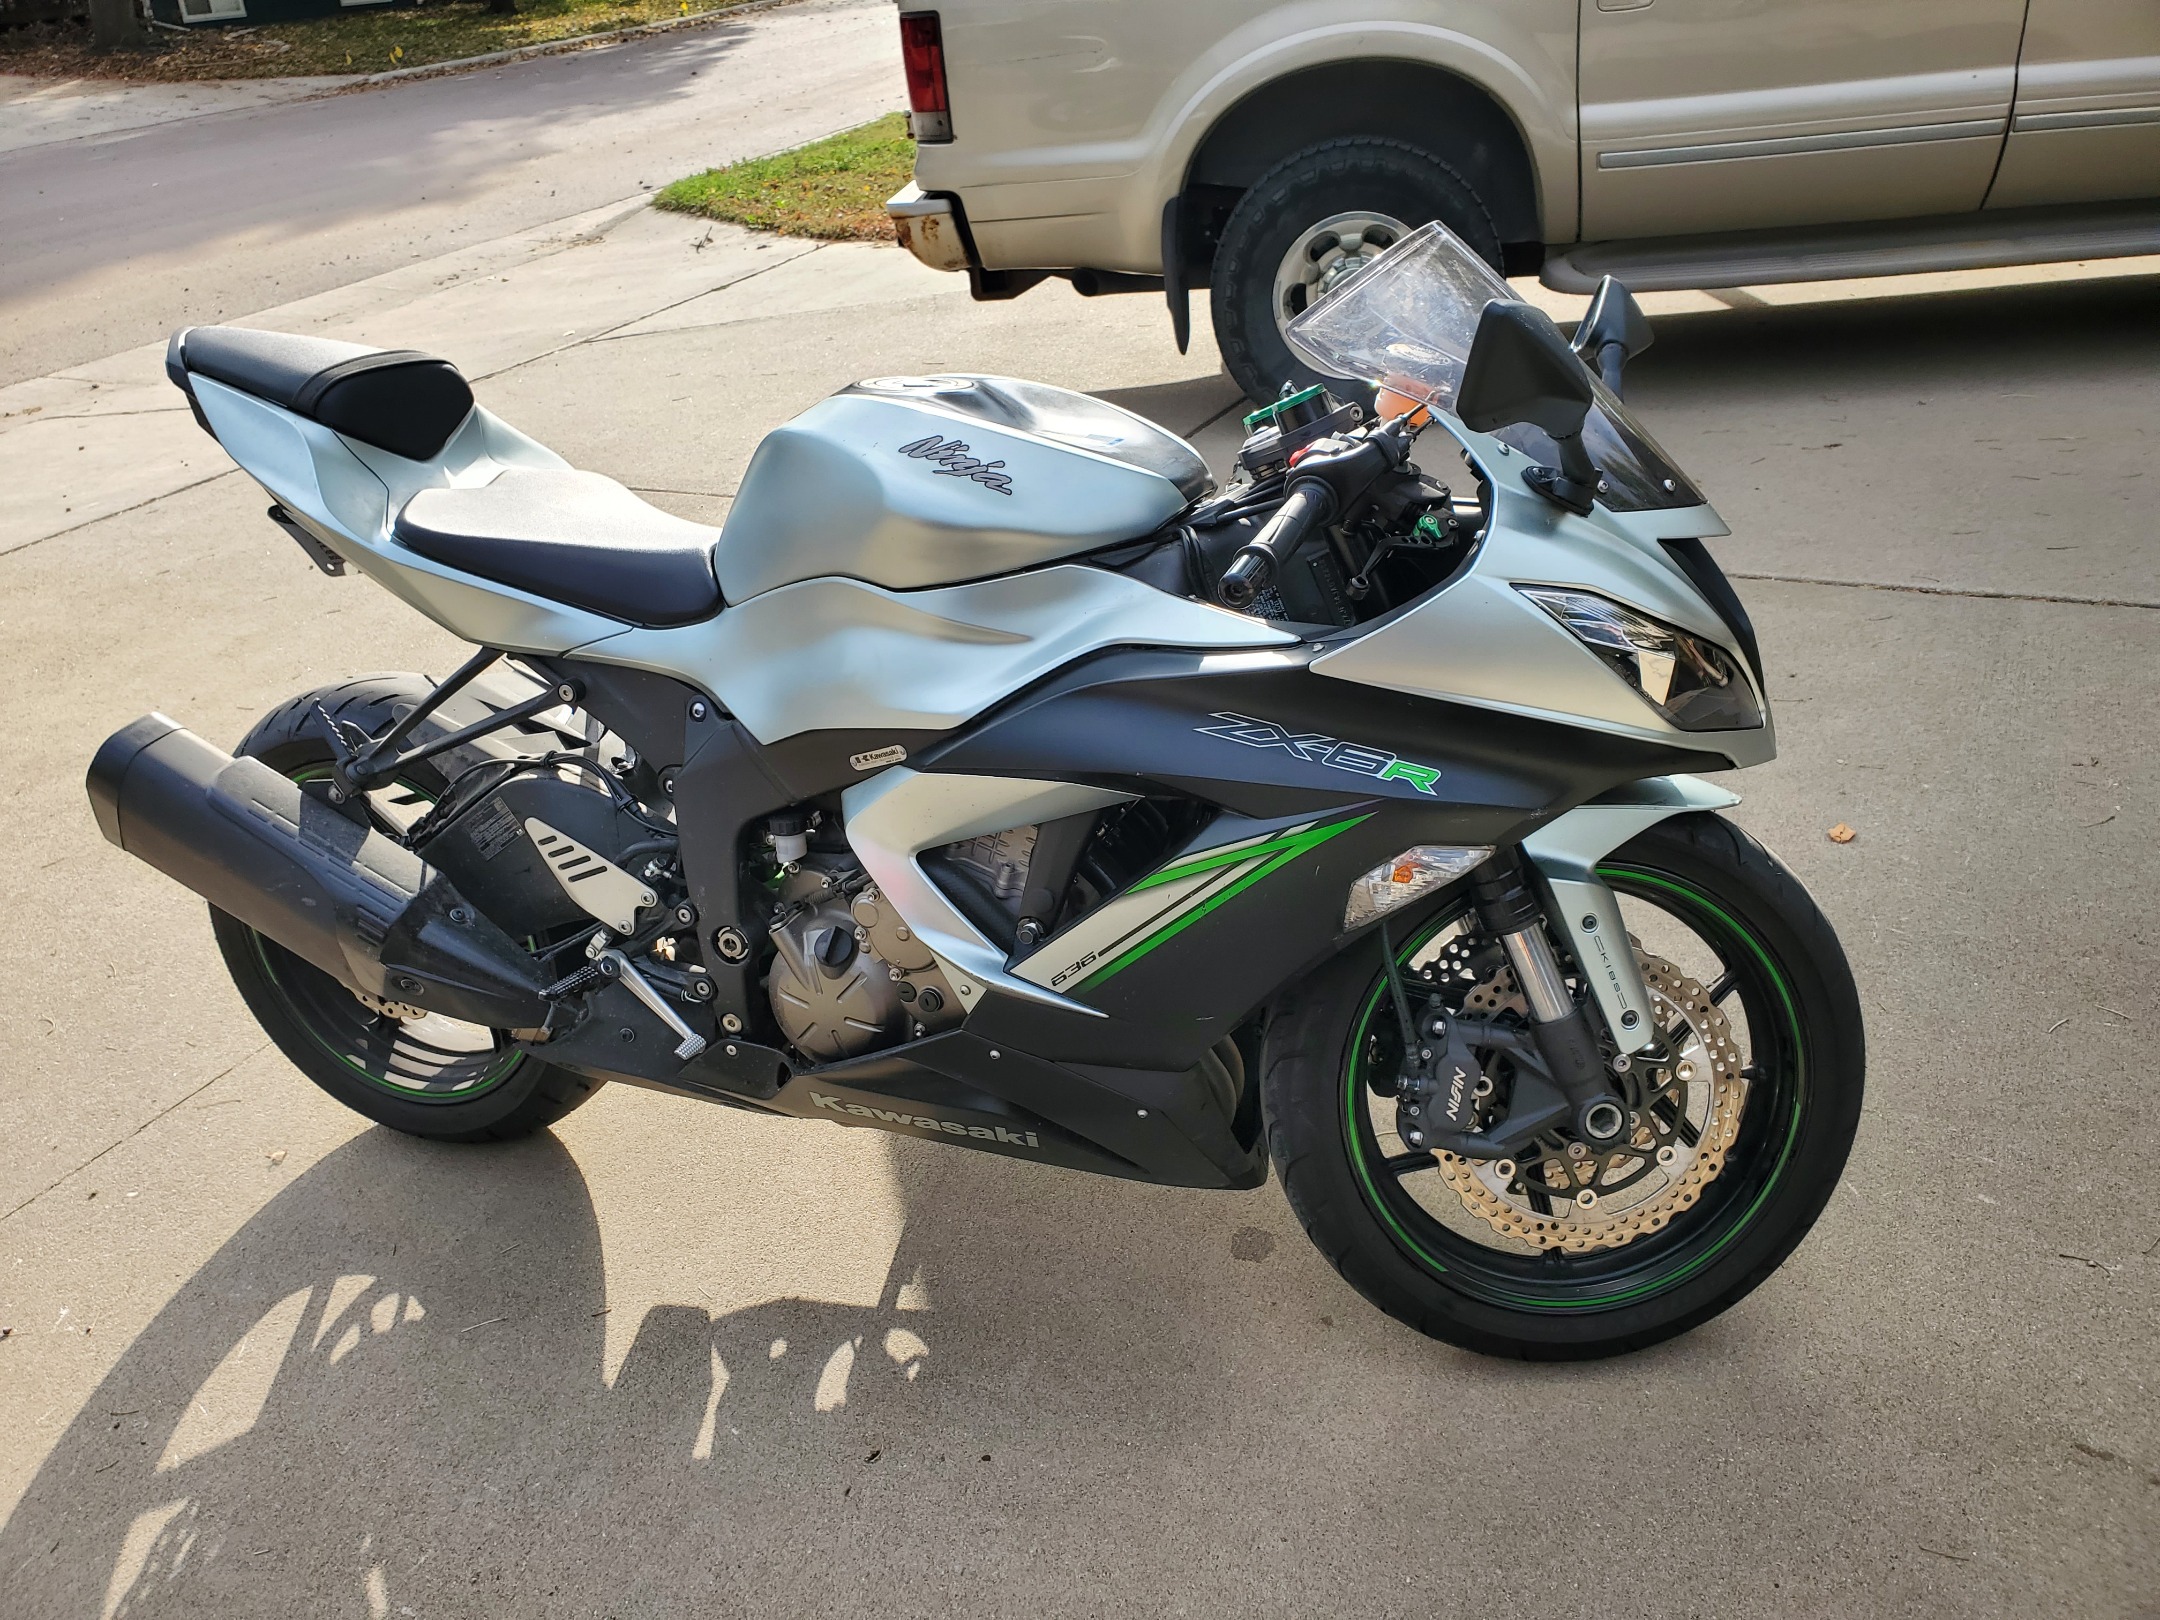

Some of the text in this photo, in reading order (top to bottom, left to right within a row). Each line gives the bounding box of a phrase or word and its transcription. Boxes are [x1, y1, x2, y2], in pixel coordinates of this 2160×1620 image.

[898, 435, 1012, 495] Ninja
[869, 747, 899, 760] Kawasaki
[1193, 711, 1442, 796] ZX-6R
[1051, 951, 1097, 987] 636
[1601, 952, 1621, 992] KIBS
[809, 1091, 1039, 1148] Kawasaki
[1446, 1066, 1467, 1121] NISSIN
